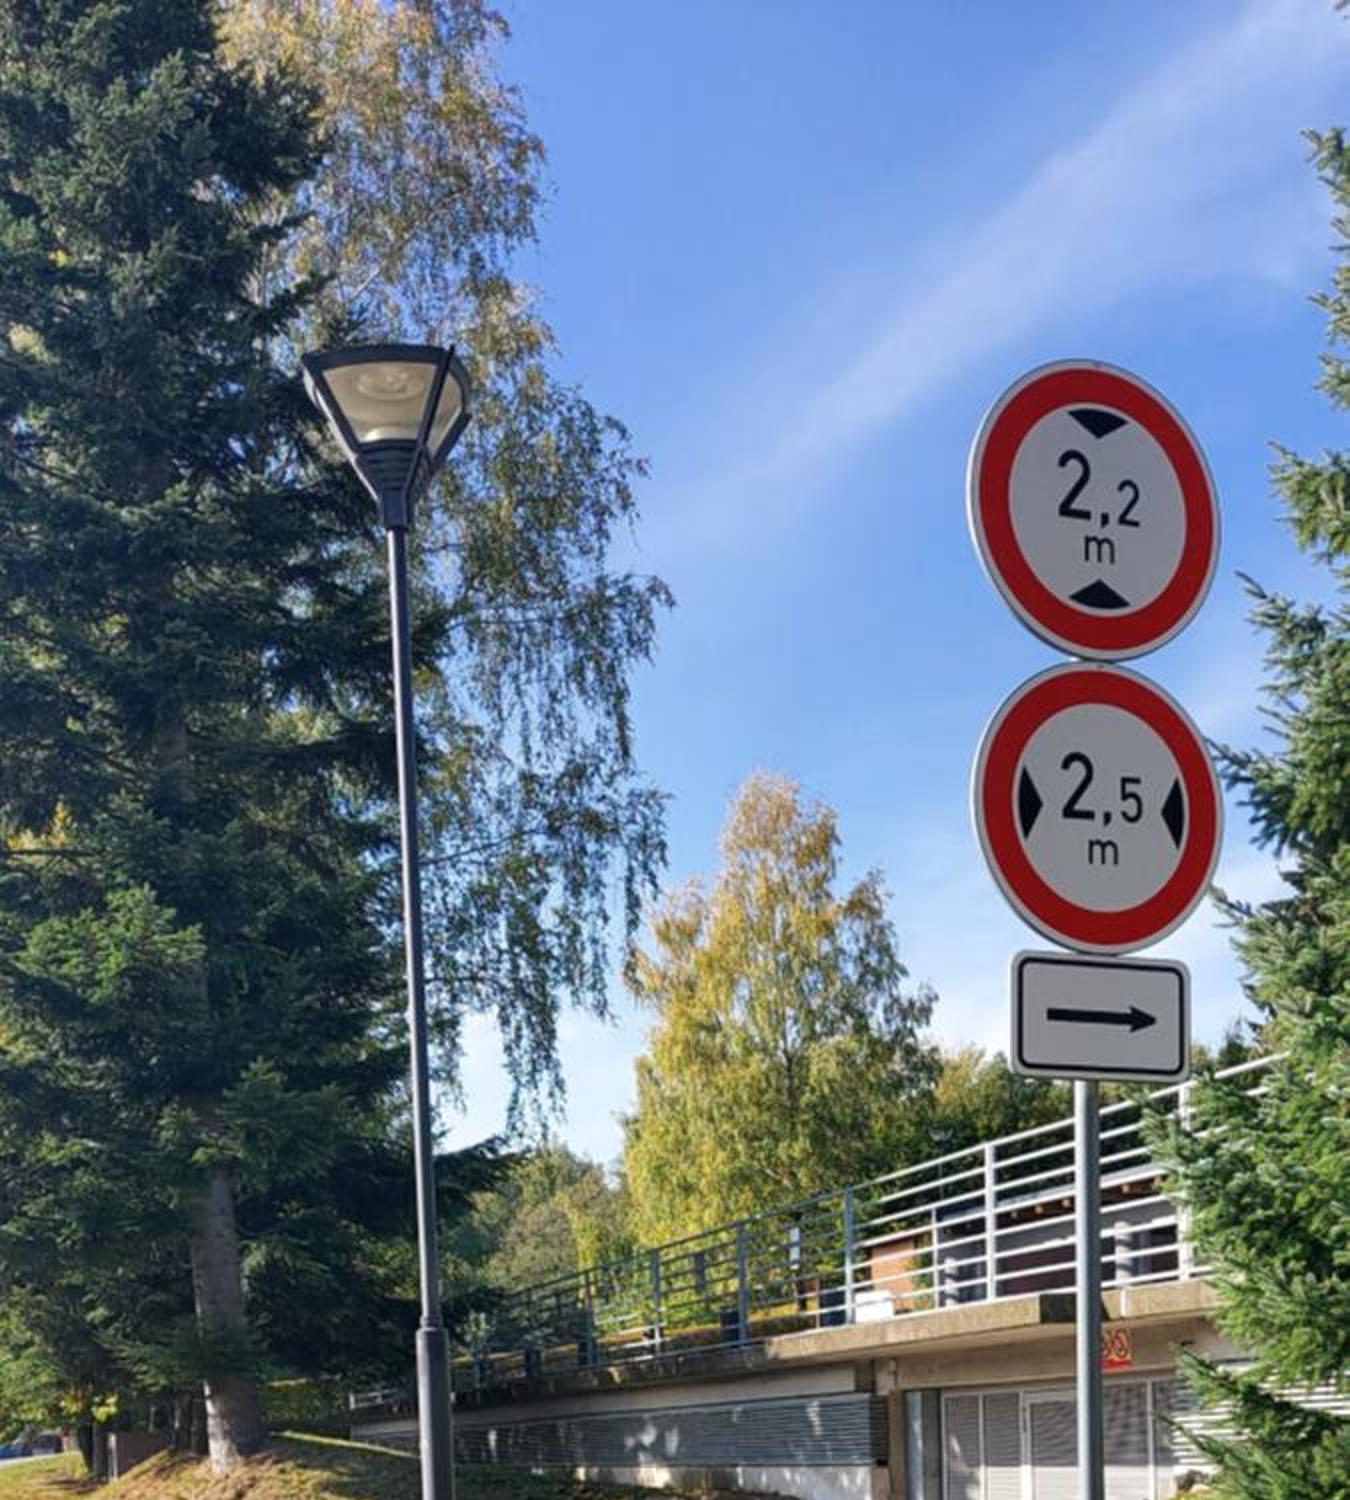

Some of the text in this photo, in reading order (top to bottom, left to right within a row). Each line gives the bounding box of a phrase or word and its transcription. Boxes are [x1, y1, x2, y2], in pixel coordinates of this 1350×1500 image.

[1057, 449, 1141, 528] 2,2
[1083, 535, 1116, 564] m
[1060, 751, 1144, 827] 2,5
[1087, 838, 1119, 866] m
